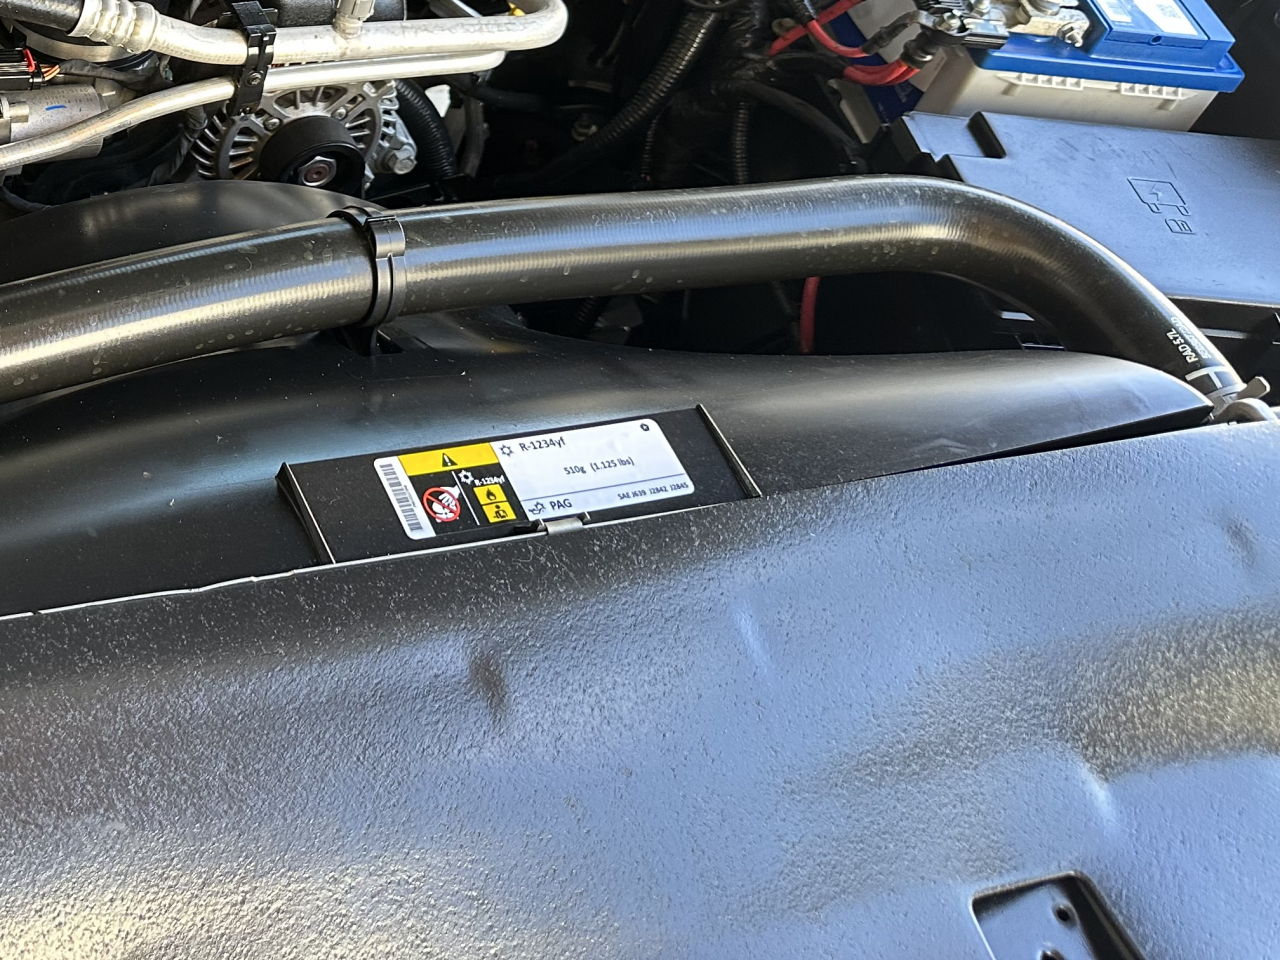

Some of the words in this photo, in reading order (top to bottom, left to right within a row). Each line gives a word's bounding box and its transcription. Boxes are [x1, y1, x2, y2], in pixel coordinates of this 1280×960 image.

[1166, 327, 1185, 345] 5.7L
[1178, 344, 1199, 363] RAD
[519, 437, 565, 452] R-1234yf
[564, 465, 587, 476] 510g
[589, 460, 617, 473] (1.125
[617, 456, 635, 467] lbs)
[617, 491, 631, 500] SAE
[632, 489, 647, 499] J639
[549, 498, 573, 510] PAG
